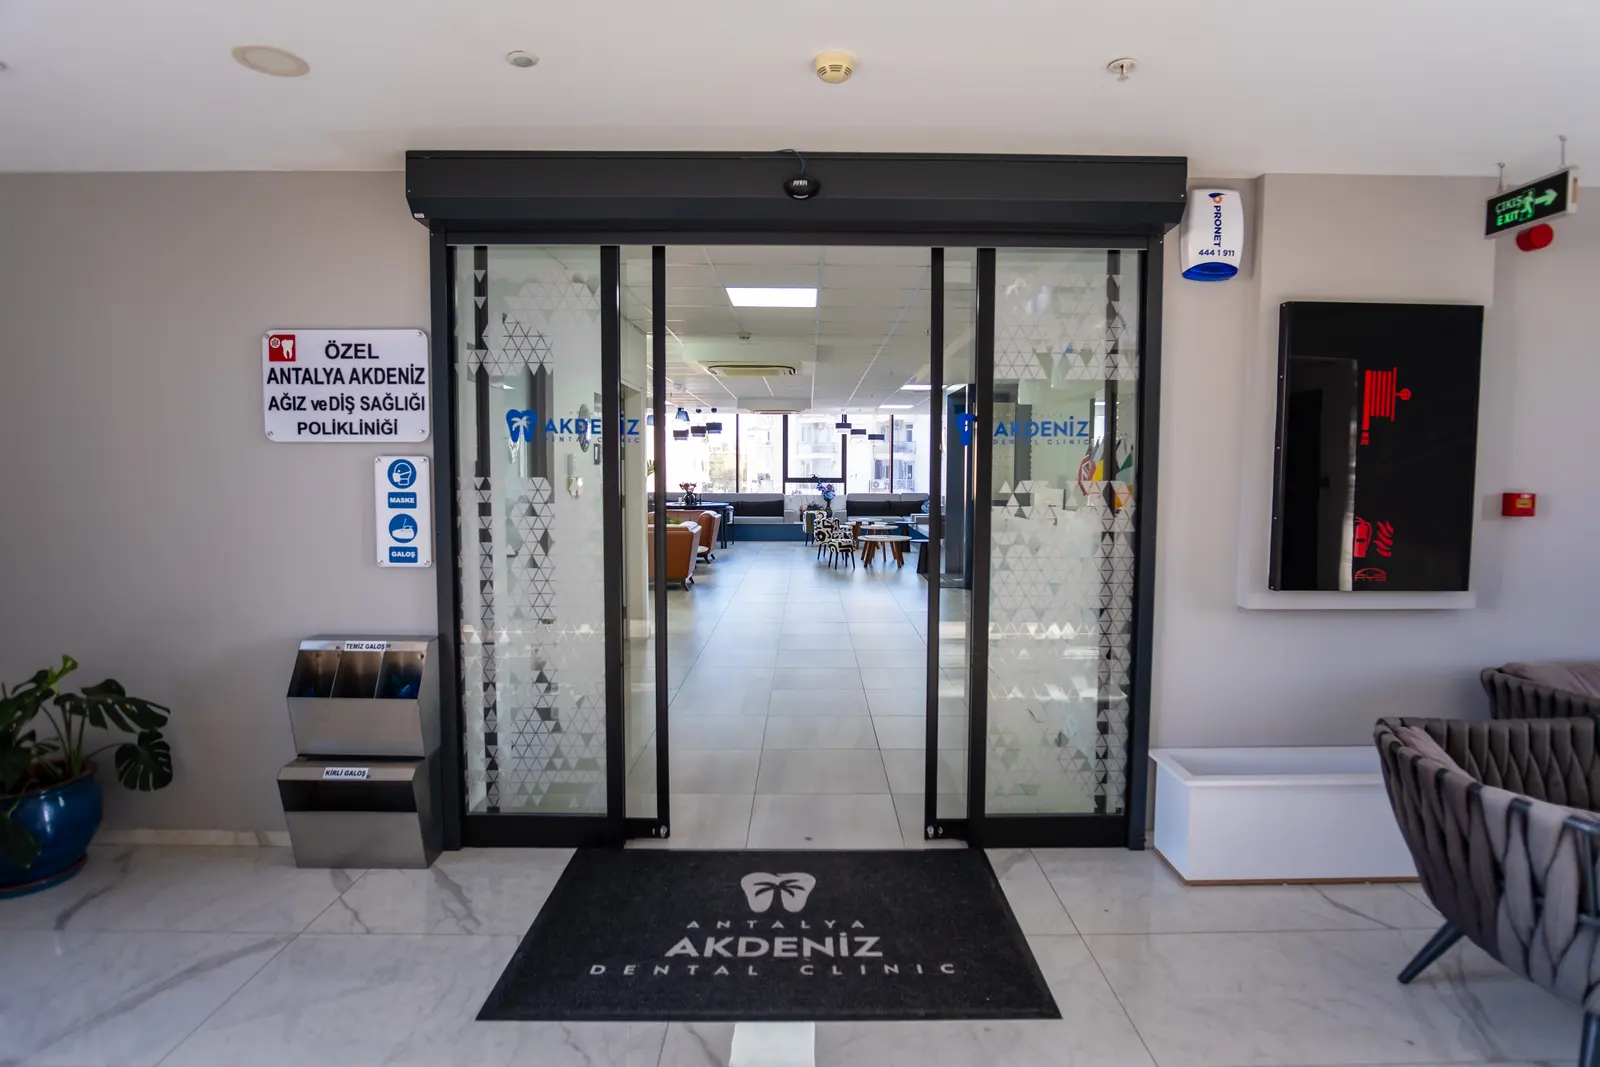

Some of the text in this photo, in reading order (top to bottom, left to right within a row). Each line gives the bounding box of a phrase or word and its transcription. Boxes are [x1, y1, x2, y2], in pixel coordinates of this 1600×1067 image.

[1214, 205, 1222, 247] PRONET
[1496, 209, 1519, 226] EXIT
[325, 340, 379, 360] ÖZEL
[266, 363, 426, 385] ANTALYA AKDENİZ
[268, 392, 425, 415] AĞIZ ve DİŞ SAĞLIĞI
[297, 418, 398, 435] POLİKLİNİĞİ
[544, 412, 640, 435] AKDEİZ
[993, 415, 1090, 437] AKDENİZ
[686, 920, 865, 929] ANTALYA
[664, 932, 883, 958] AKDENİZ
[589, 963, 955, 976] DENTAL CLINIC
